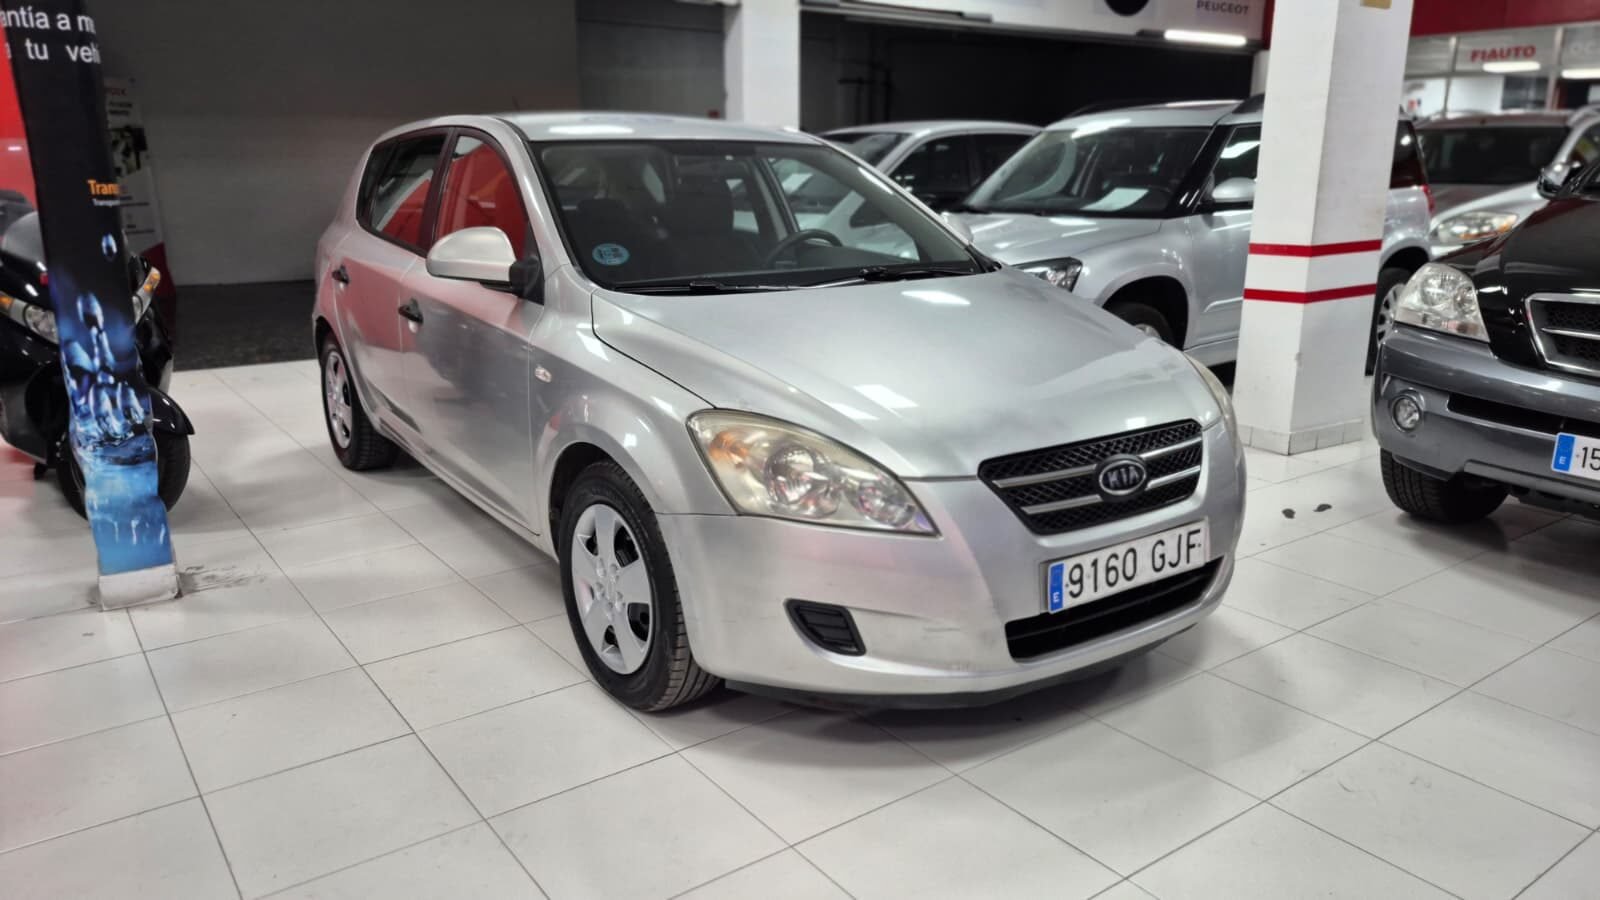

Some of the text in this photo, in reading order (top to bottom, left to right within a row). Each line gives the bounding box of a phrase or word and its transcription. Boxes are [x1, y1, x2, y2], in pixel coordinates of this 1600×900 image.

[1197, 0, 1249, 15] PEUGEOT
[56, 13, 71, 31] a
[25, 38, 49, 60] tu
[1470, 45, 1537, 62] FIAUTO
[1581, 446, 1600, 472] 15
[1107, 466, 1140, 489] KIA
[1068, 547, 1138, 599] 9160
[1151, 528, 1202, 573] GJF
